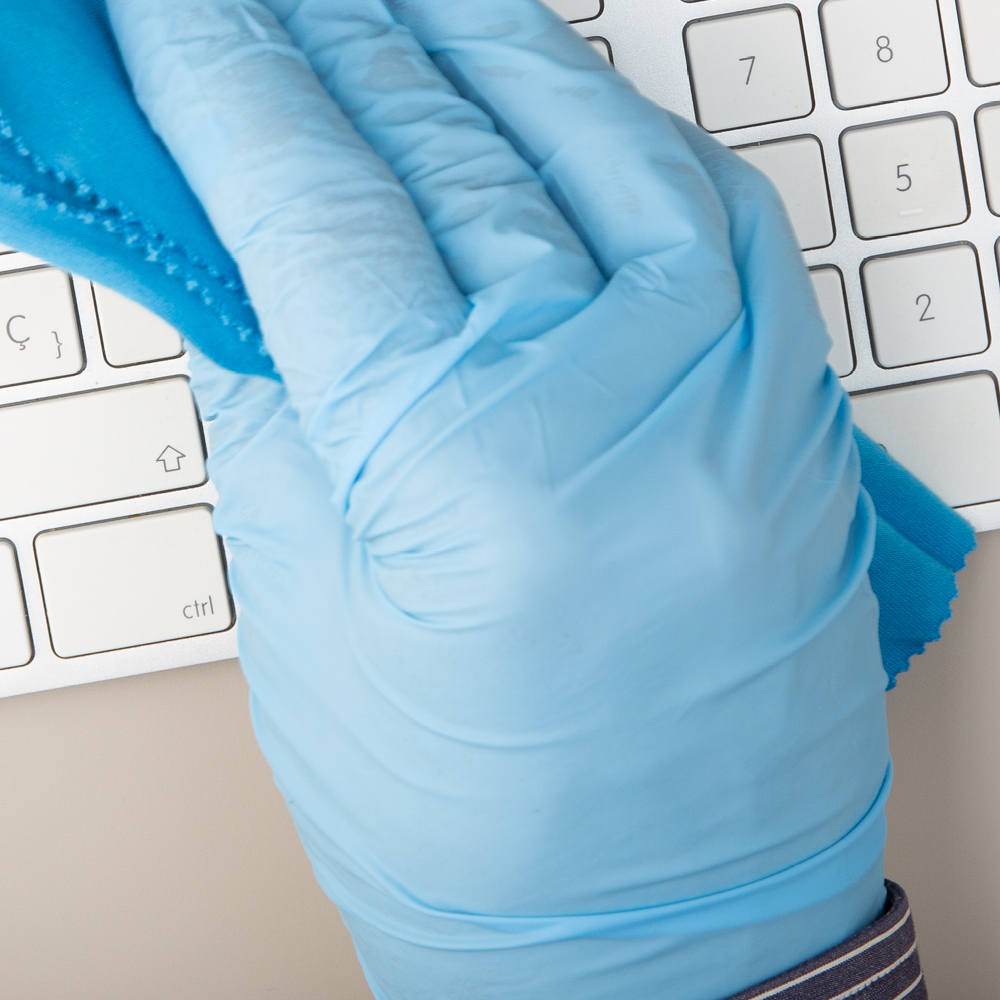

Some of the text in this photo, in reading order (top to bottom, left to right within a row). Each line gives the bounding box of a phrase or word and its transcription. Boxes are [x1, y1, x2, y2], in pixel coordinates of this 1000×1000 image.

[875, 35, 894, 64] 8
[738, 55, 756, 86] 7
[896, 163, 912, 192] 5
[915, 293, 935, 322] 2
[5, 314, 31, 351] Ç
[182, 595, 215, 620] ctrl
